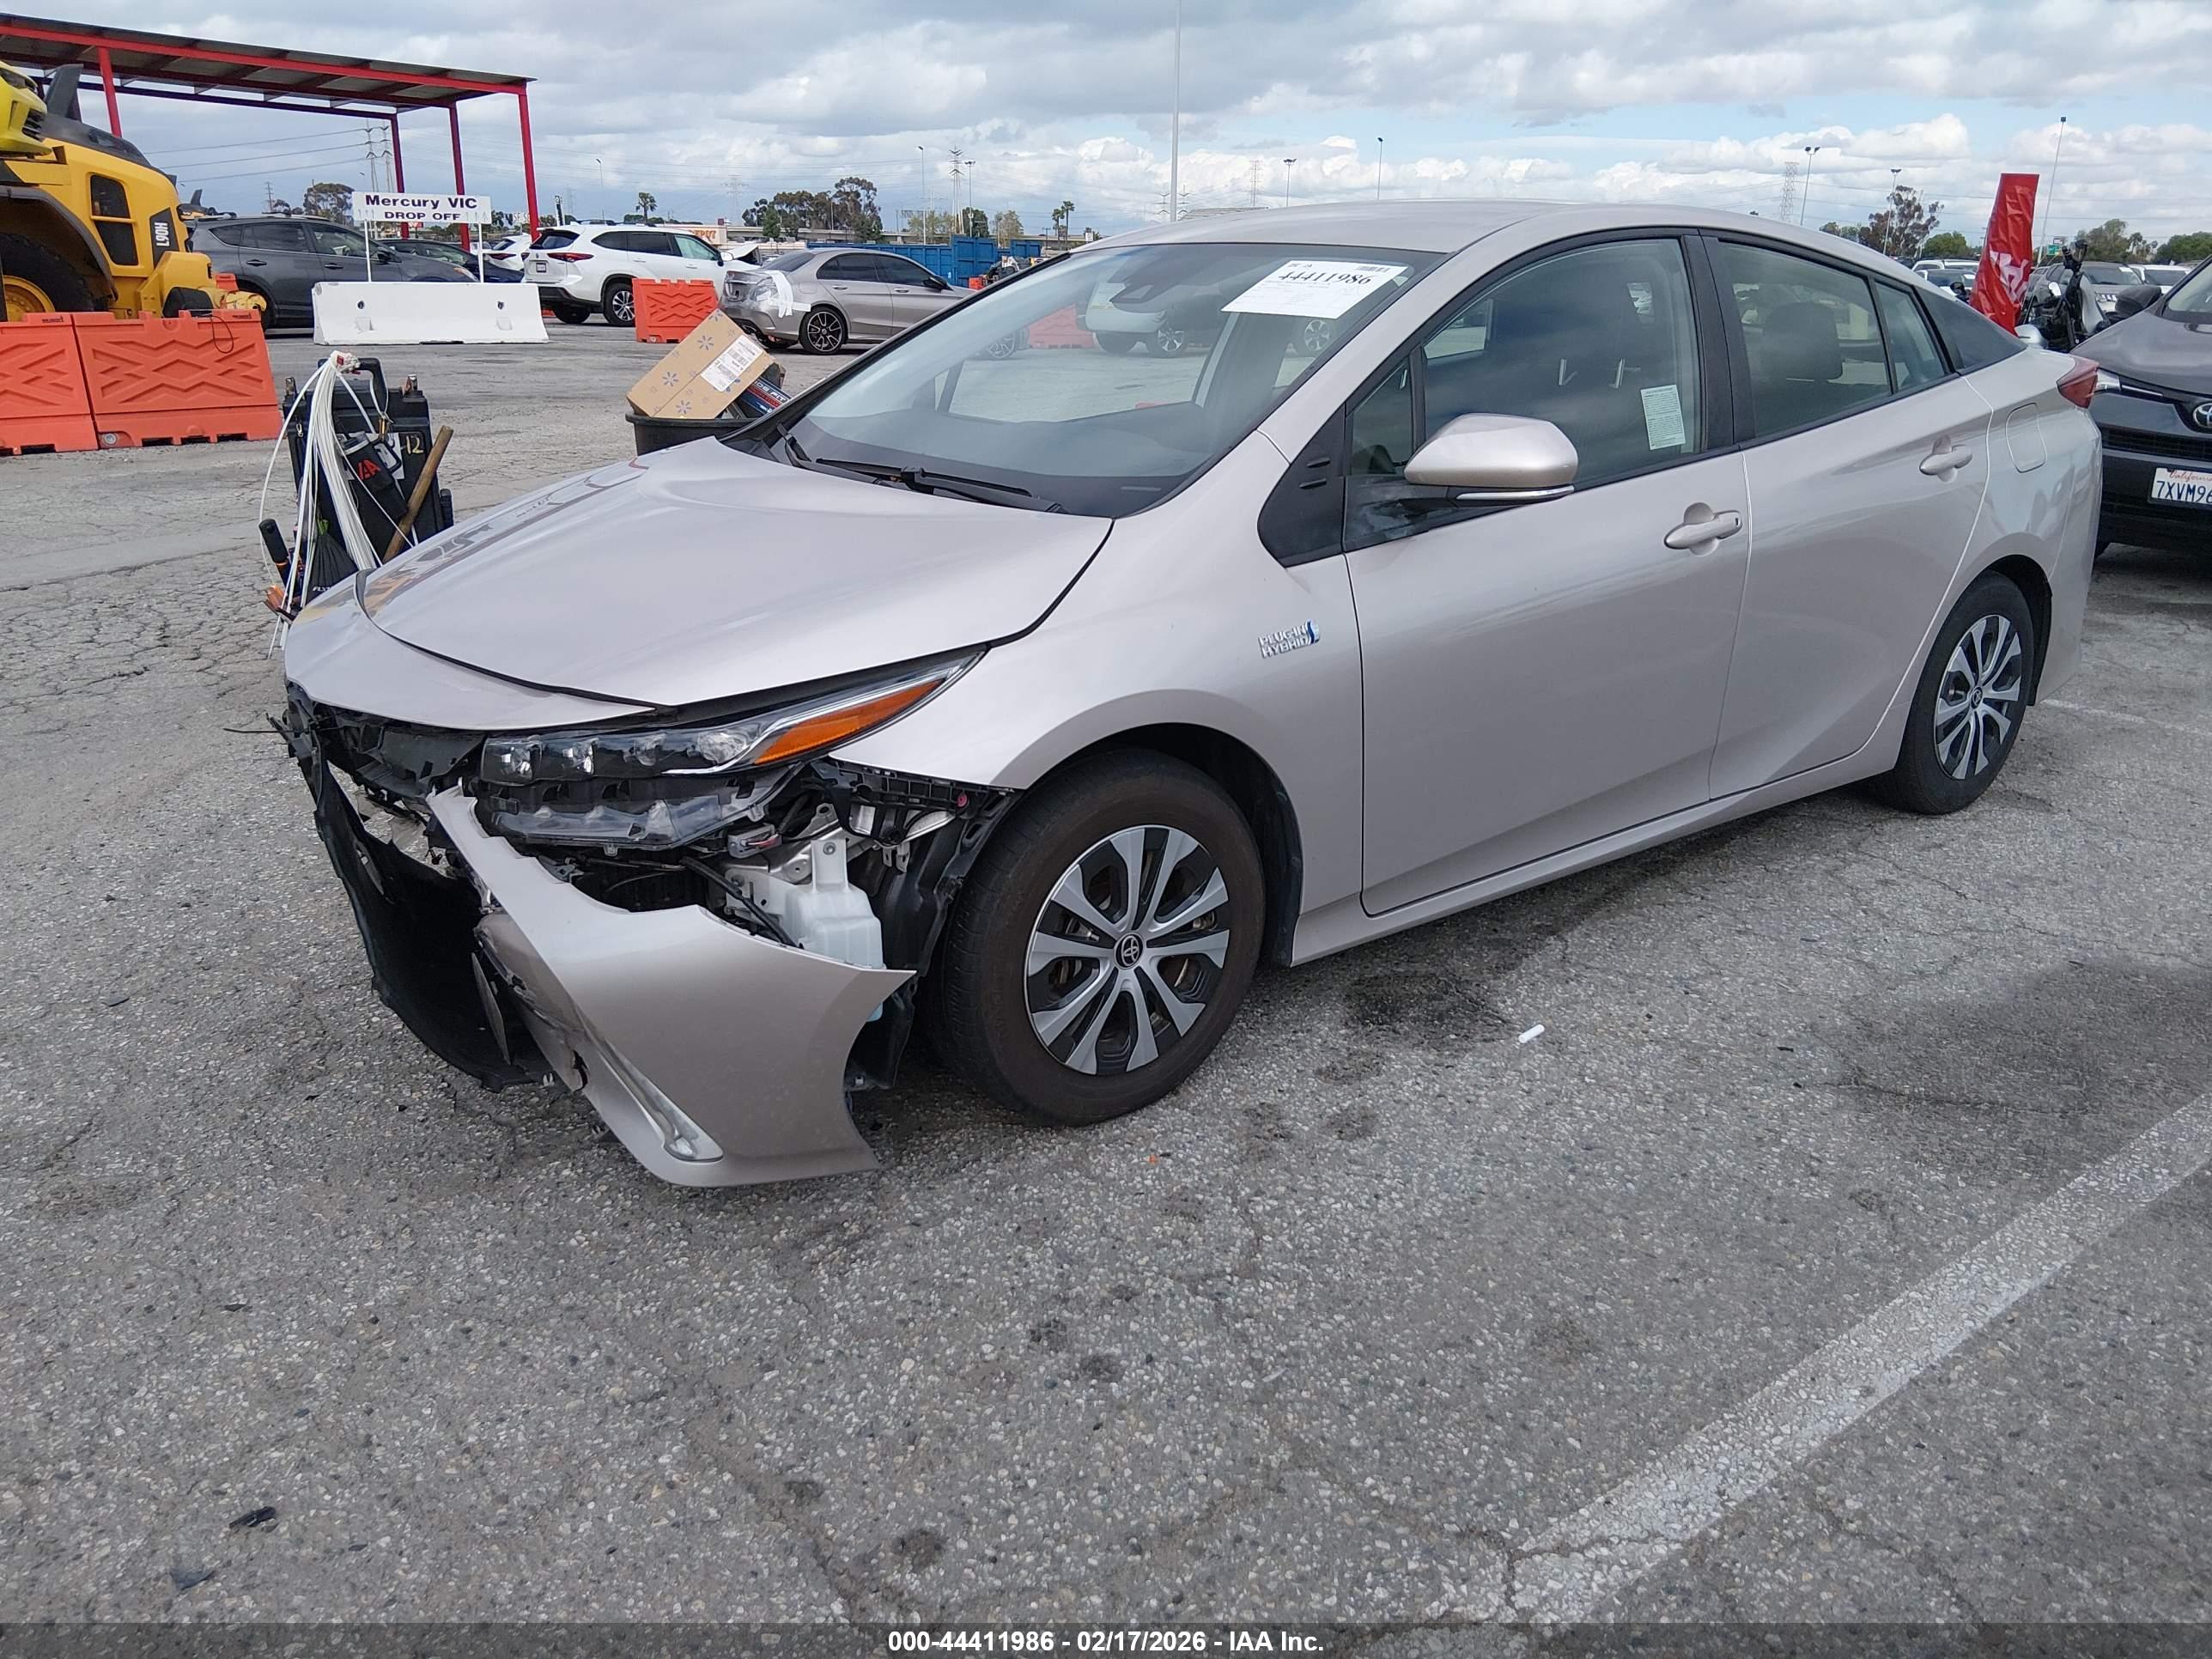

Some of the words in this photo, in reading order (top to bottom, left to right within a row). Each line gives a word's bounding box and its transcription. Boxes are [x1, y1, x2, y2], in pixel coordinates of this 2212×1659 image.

[365, 194, 440, 210] Mercury
[447, 197, 477, 209] VIC
[384, 211, 426, 220] DROP
[432, 212, 461, 221] OFF
[154, 222, 170, 246] L90H
[1278, 271, 1372, 285] 44411986
[405, 434, 424, 454] 12
[1261, 637, 1310, 659] HYBRID
